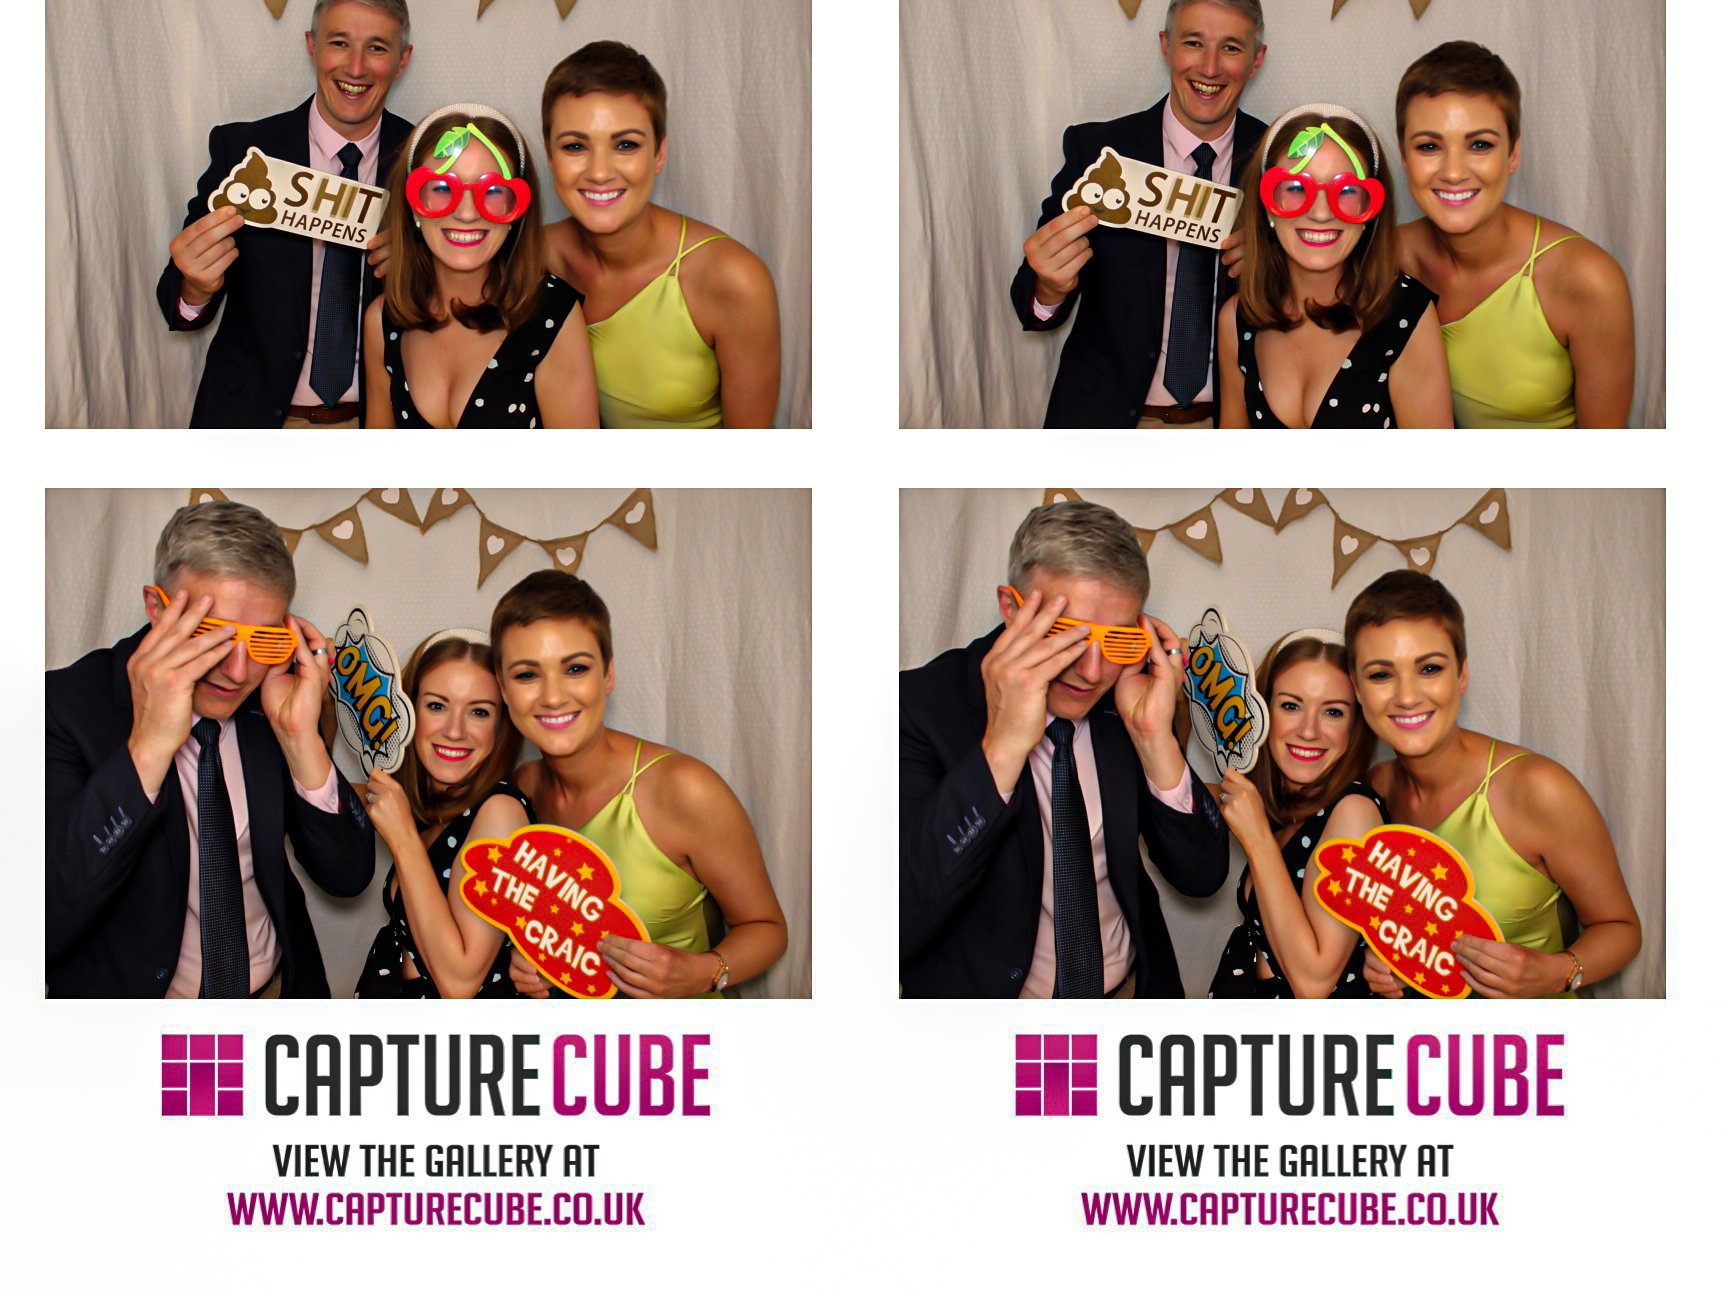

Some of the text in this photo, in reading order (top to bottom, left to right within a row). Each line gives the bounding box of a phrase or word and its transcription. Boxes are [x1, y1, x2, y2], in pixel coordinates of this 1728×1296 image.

[283, 171, 383, 224] SHIT
[1137, 171, 1237, 224] SHIT
[281, 209, 367, 243] HAPPENS
[1135, 209, 1221, 243] HAPPENS
[336, 646, 399, 751] OMG!
[1190, 646, 1253, 751] OMG!
[491, 867, 540, 912] THE
[513, 840, 604, 921] HAVING
[1345, 867, 1394, 912] THE
[1367, 840, 1458, 921] HAVING
[524, 920, 601, 976] CRAIC
[1378, 920, 1455, 976] CRAIC
